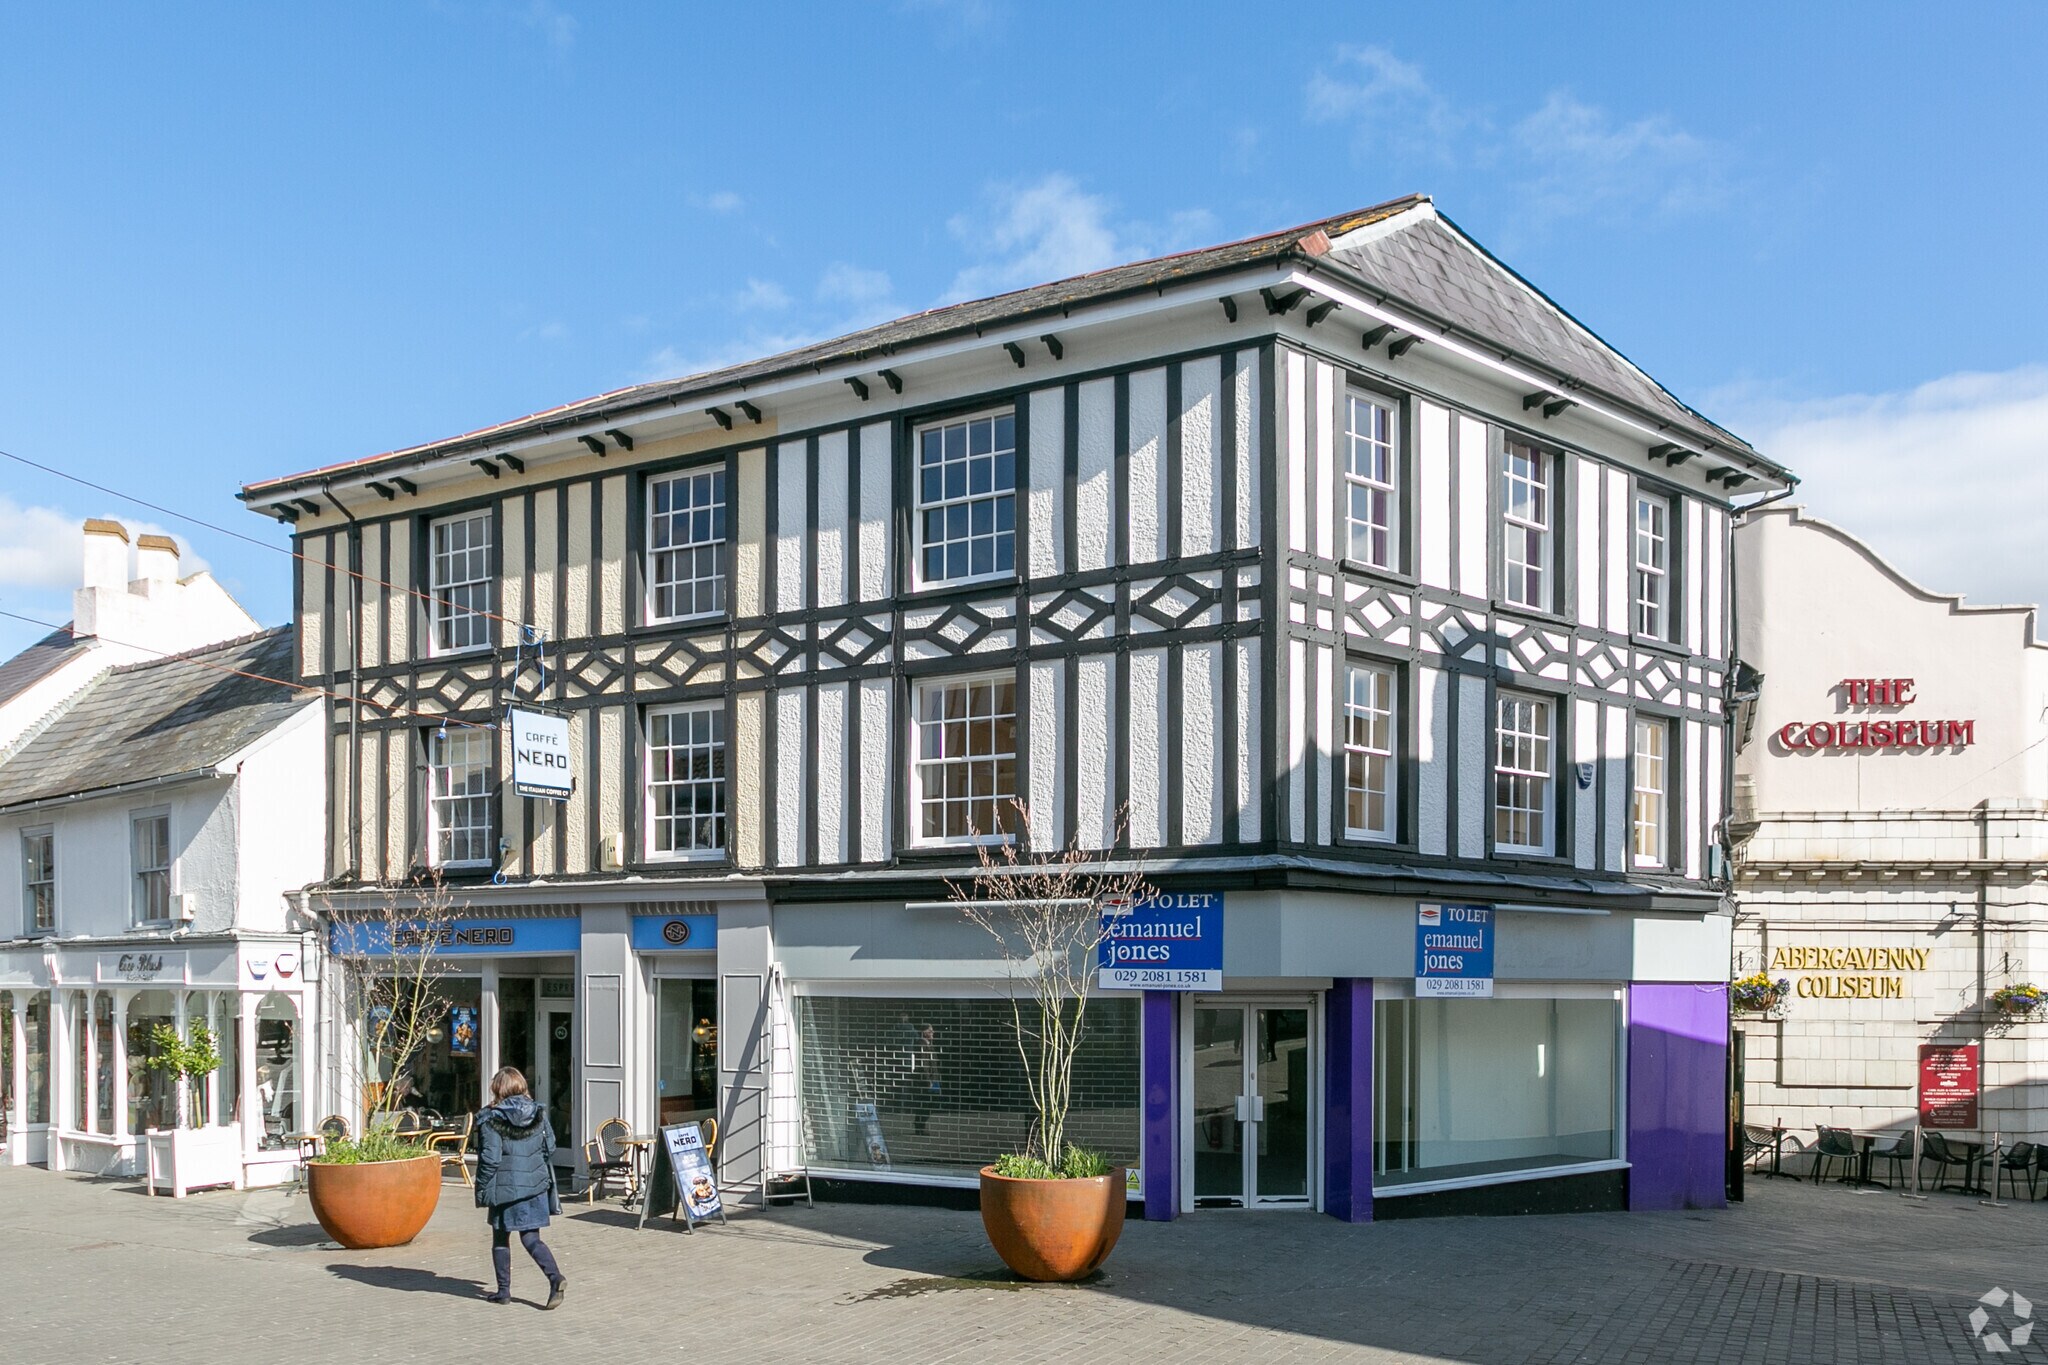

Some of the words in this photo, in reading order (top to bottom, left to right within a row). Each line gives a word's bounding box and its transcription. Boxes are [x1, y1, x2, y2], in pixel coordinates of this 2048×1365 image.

[1840, 678, 1917, 705] THE
[1779, 719, 1976, 749] COLISEUM
[518, 749, 567, 769] NERO
[1147, 894, 1173, 909] TO
[1177, 894, 1213, 908] LET
[1448, 908, 1465, 921] TO
[1467, 909, 1488, 923] LET
[455, 927, 514, 945] NERO
[1111, 916, 1202, 938] emanuel
[1424, 929, 1483, 949] emanuel
[1109, 940, 1170, 967] jones
[1422, 949, 1463, 976] jones
[1770, 946, 1929, 971] ABERGAVENNY
[1114, 971, 1137, 982] 029
[1141, 971, 1171, 982] 2081
[1178, 971, 1207, 983] 1581
[1426, 979, 1442, 990] 029
[1444, 979, 1463, 990] 2081
[1466, 980, 1484, 990] 1581
[1797, 975, 1904, 999] COLISEUM
[673, 1136, 697, 1147] NERO
